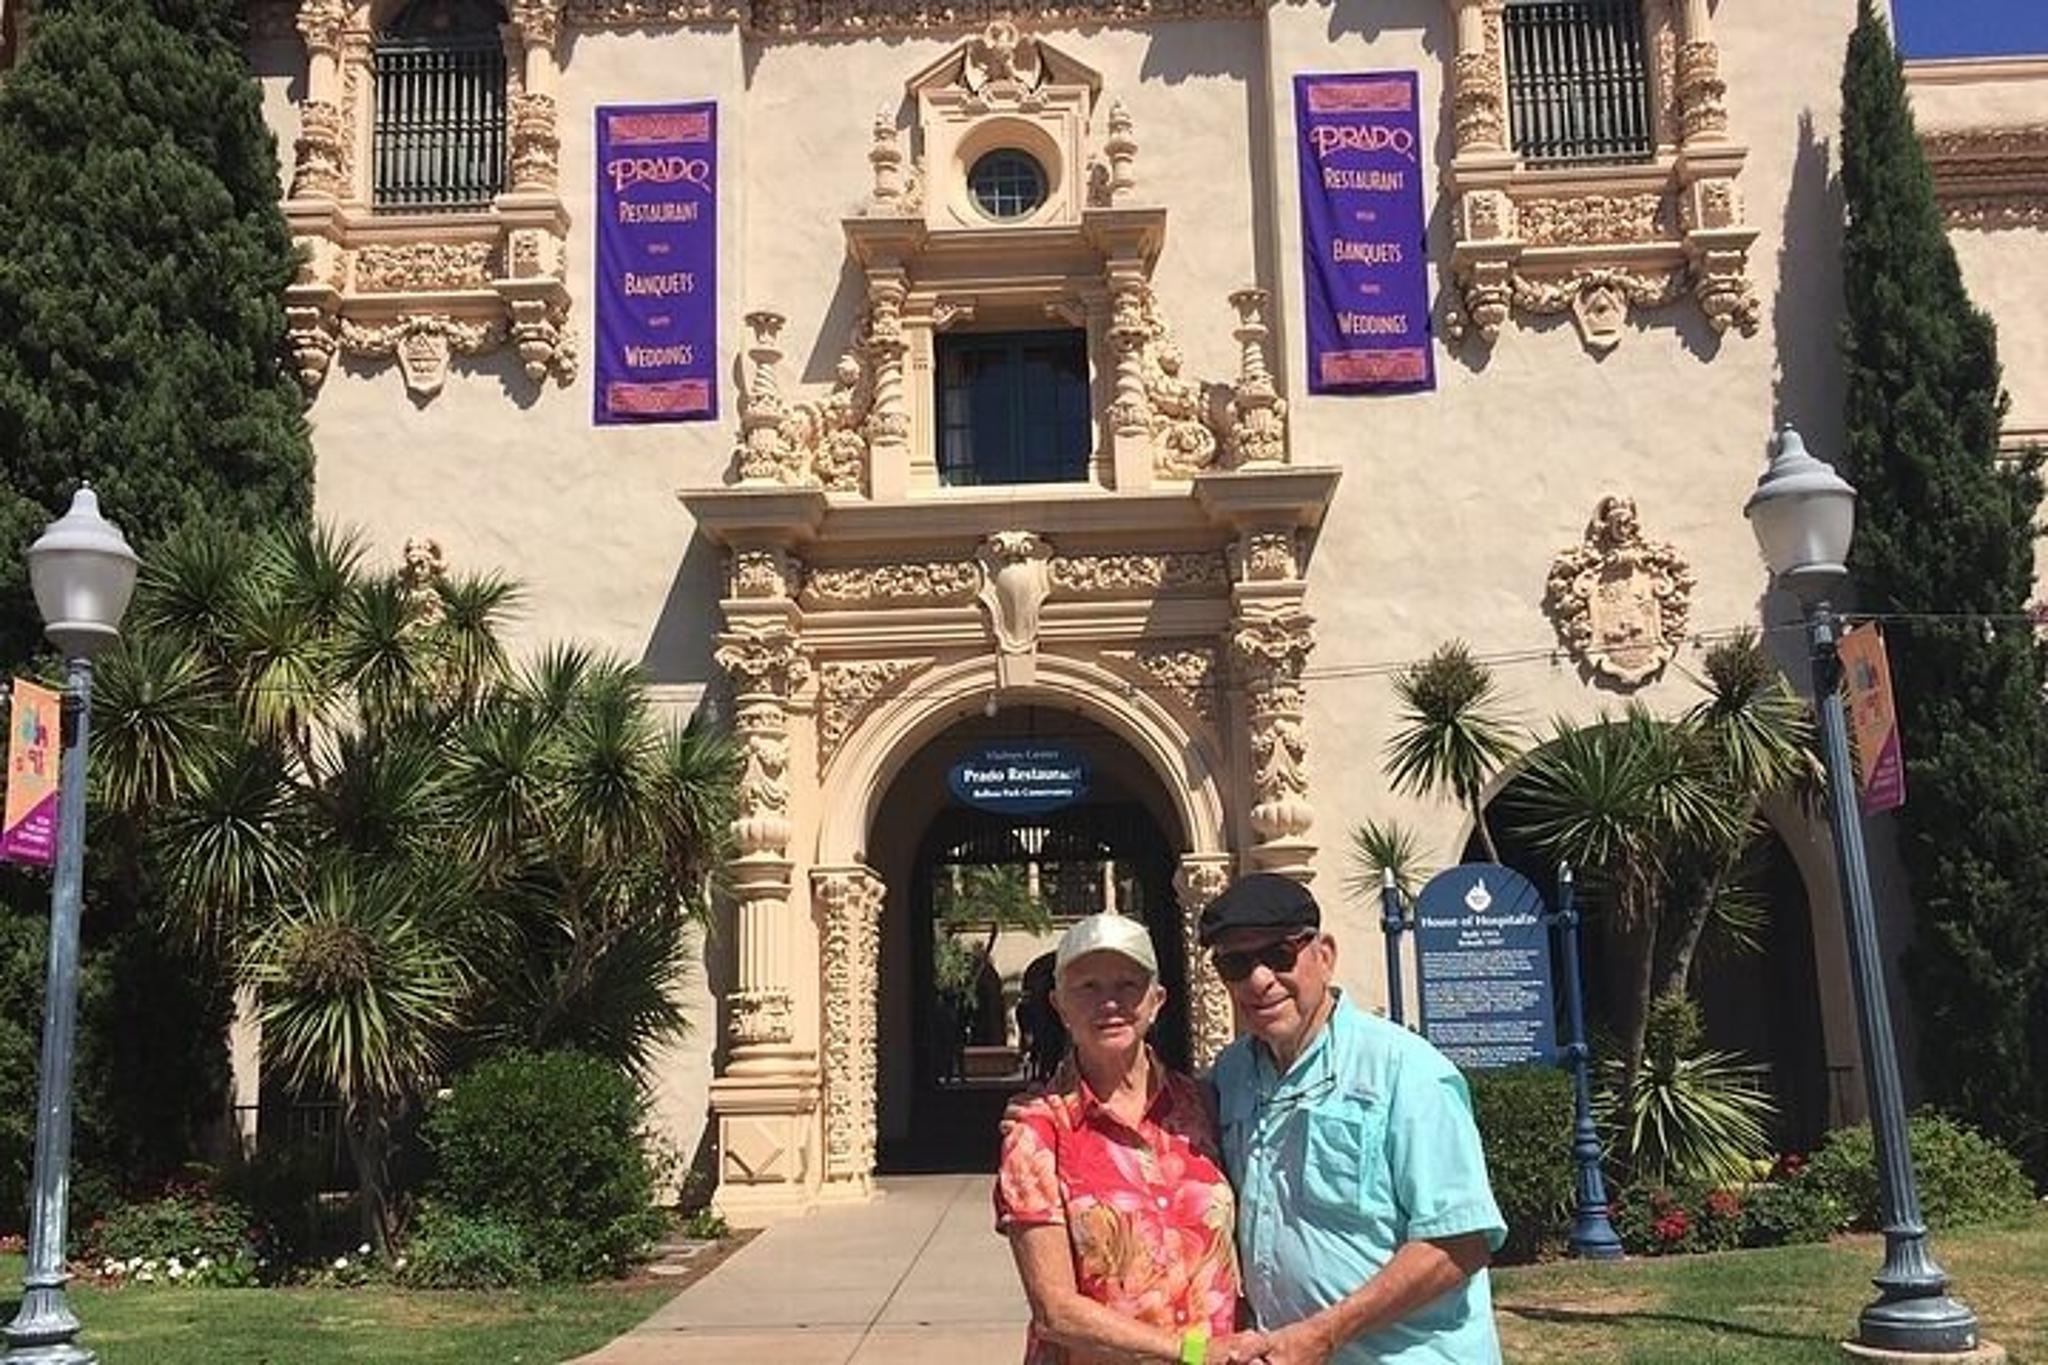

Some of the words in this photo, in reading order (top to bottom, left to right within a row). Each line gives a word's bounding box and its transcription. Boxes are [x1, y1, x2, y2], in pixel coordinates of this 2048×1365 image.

[1310, 124, 1415, 162] PRADO
[608, 157, 711, 193] PRADO
[1324, 166, 1404, 191] RESTAURANT
[619, 201, 698, 223] RESTAURANT
[1333, 238, 1402, 267] BANQUETS
[625, 272, 694, 297] BANQUETS
[1338, 312, 1409, 334] WEDDINGS
[625, 344, 693, 367] WEDDINGS
[963, 769, 1005, 783] Prado
[1421, 916, 1458, 927] House
[1461, 915, 1473, 926] of
